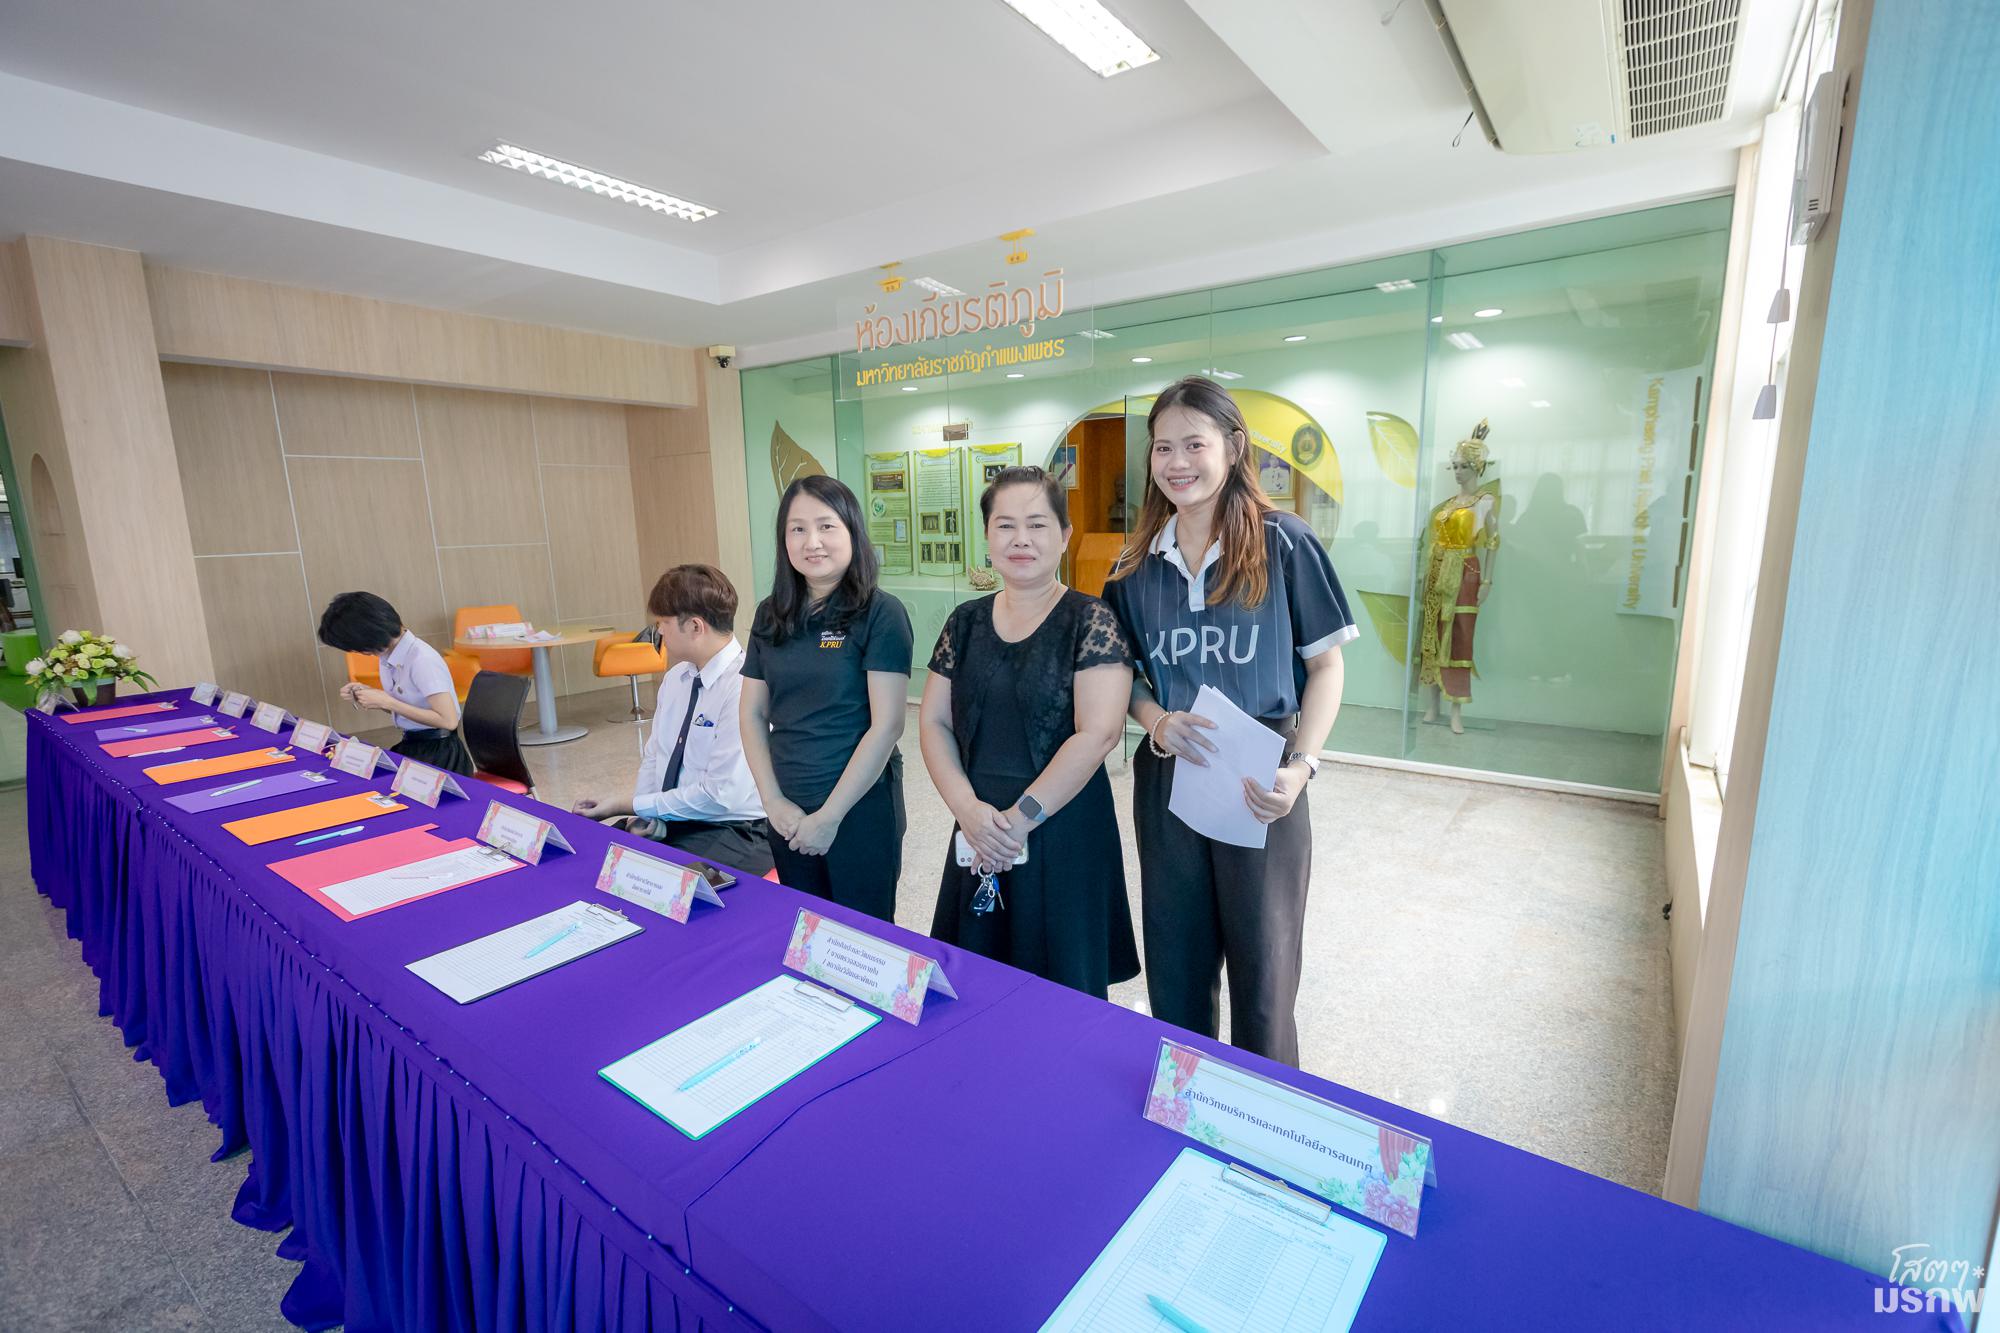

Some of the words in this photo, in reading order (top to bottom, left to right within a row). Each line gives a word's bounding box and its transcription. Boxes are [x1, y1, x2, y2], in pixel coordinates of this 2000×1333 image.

[1146, 624, 1260, 665] KPRU
[1184, 1087, 1373, 1173] สำนักวิทยบริการและเทคโนโลยีสารสนเทศ
